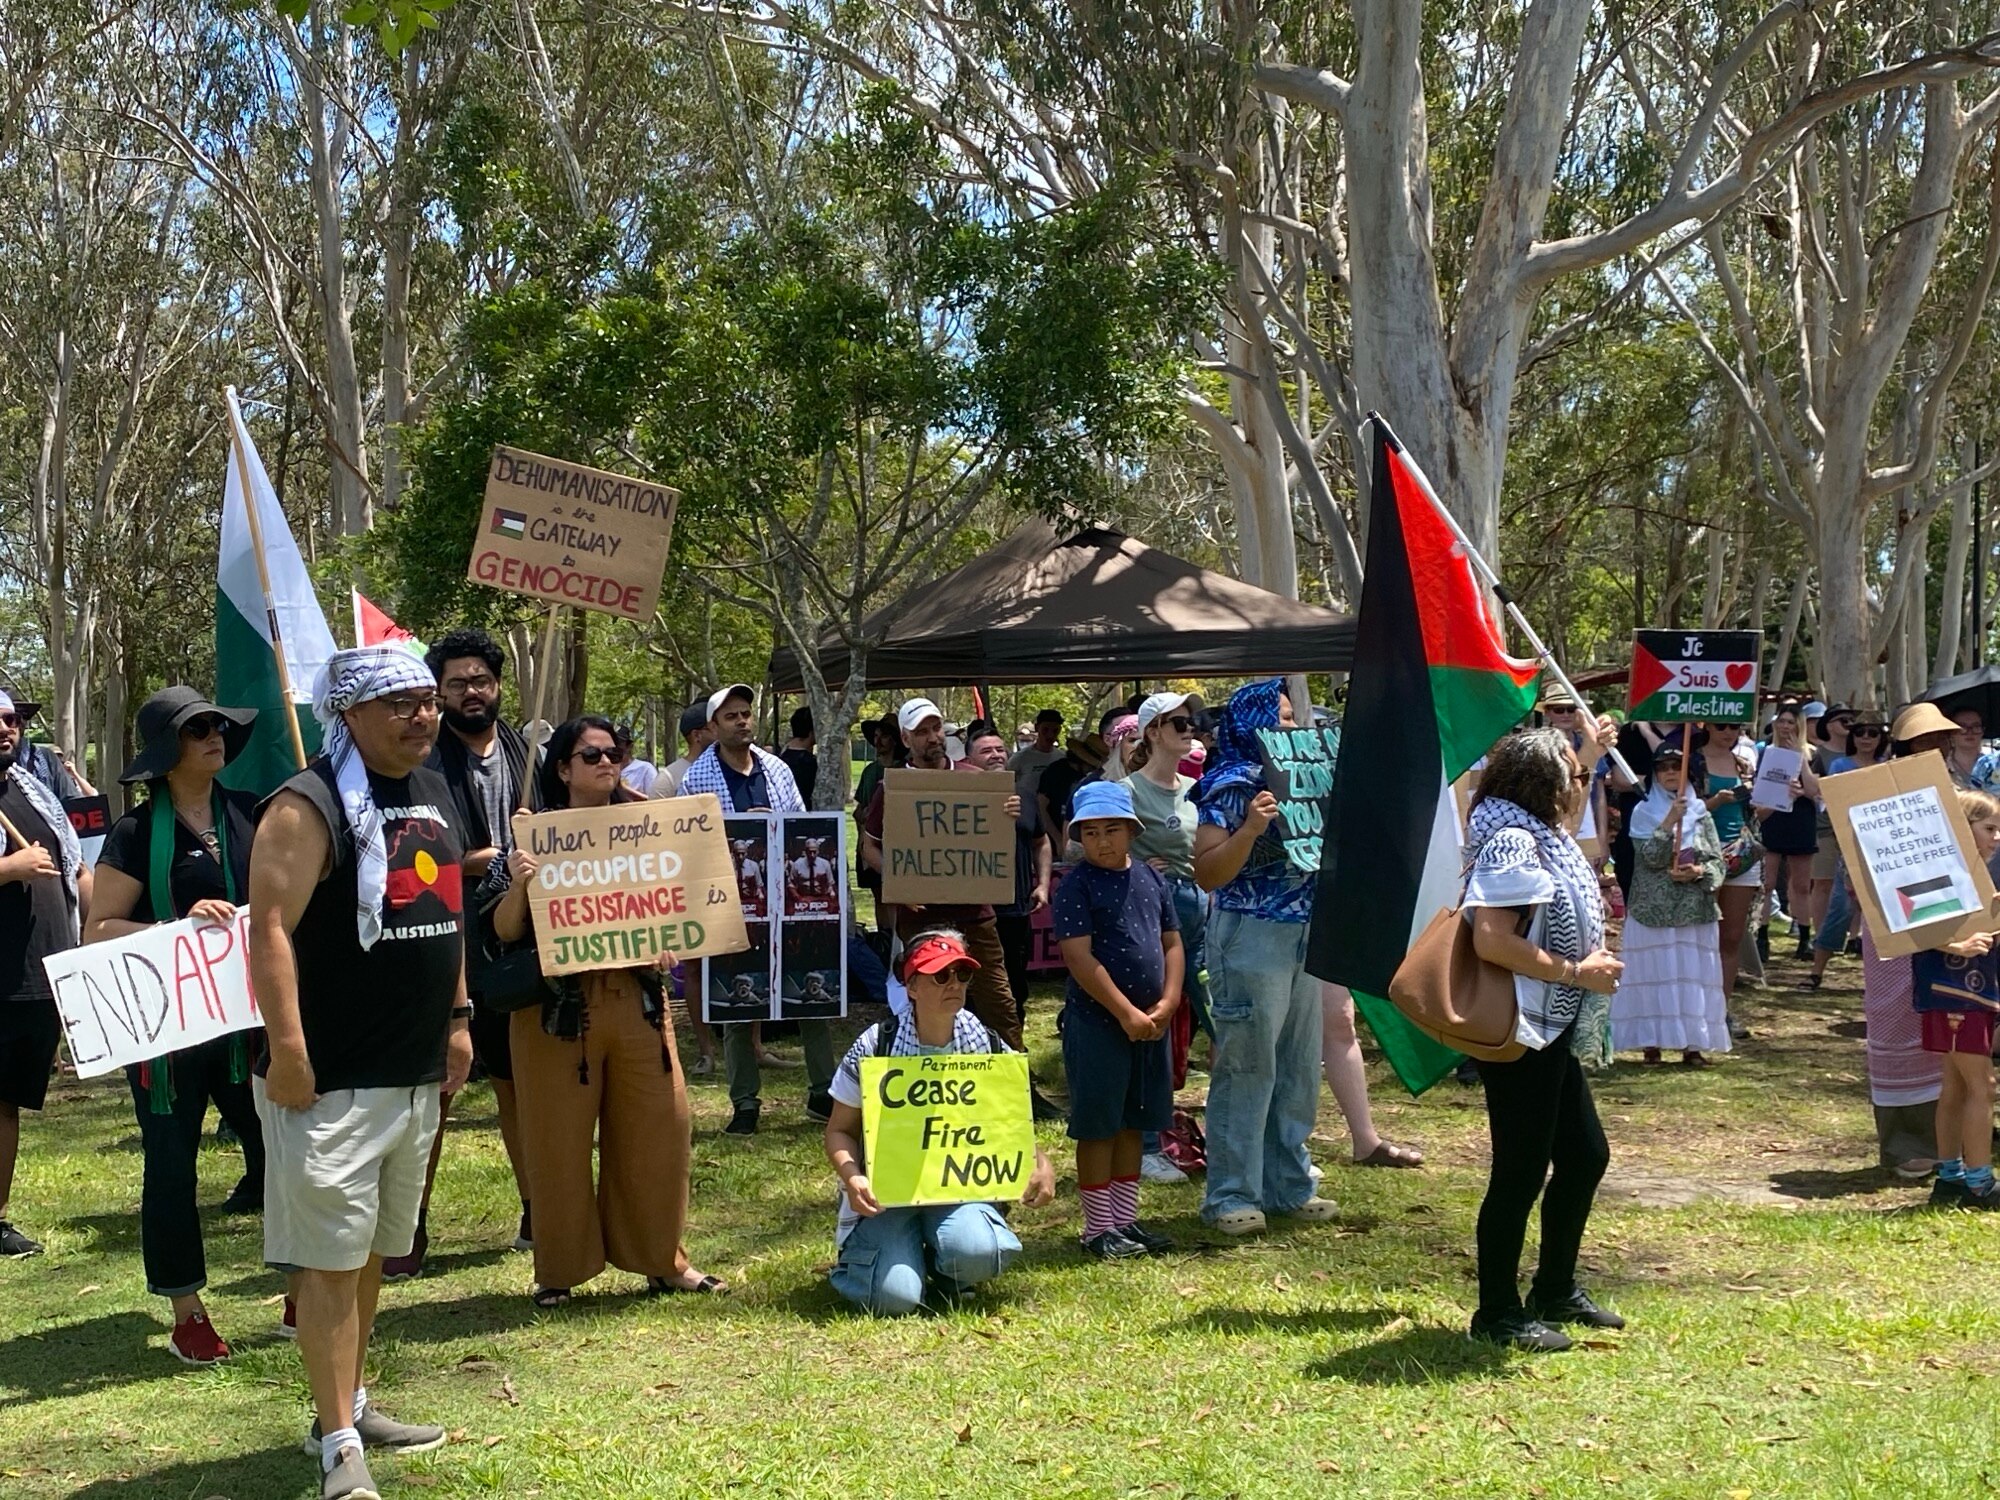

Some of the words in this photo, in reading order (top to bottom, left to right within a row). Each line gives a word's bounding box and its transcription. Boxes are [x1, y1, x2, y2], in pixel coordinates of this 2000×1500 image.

[494, 452, 673, 519] DEHUMANISATION
[530, 518, 621, 557] GATEWAY
[561, 554, 576, 567] to
[476, 551, 644, 613] GENOCIDE
[1679, 665, 1719, 688] Suis
[1666, 693, 1744, 716] Palestine
[1255, 727, 1293, 760] YOU
[915, 801, 989, 838] FREE
[1277, 800, 1324, 837] YOU
[1858, 817, 1894, 832] RIVER
[1897, 811, 1913, 823] TO
[1916, 804, 1940, 818] THE
[1863, 801, 1898, 817] FROM
[1901, 794, 1925, 806] THE
[531, 826, 596, 855] When
[609, 814, 662, 850] people
[673, 813, 713, 834] are
[1876, 833, 1942, 858] PALESTINE
[540, 851, 682, 890] OCCUPIED
[892, 848, 1008, 879] PALESTINE
[1872, 860, 1902, 874] WILL
[1904, 854, 1922, 866] BE
[1924, 845, 1956, 862] FREE
[548, 886, 687, 929] RESISTANCE
[706, 884, 727, 906] is
[382, 920, 457, 940] AUSTRALIA
[553, 920, 705, 965] JUSTIFIED
[921, 1057, 996, 1071] Permanent
[879, 1069, 976, 1108] Cease
[922, 1116, 985, 1150] Fire
[941, 1151, 1023, 1187] NOW
